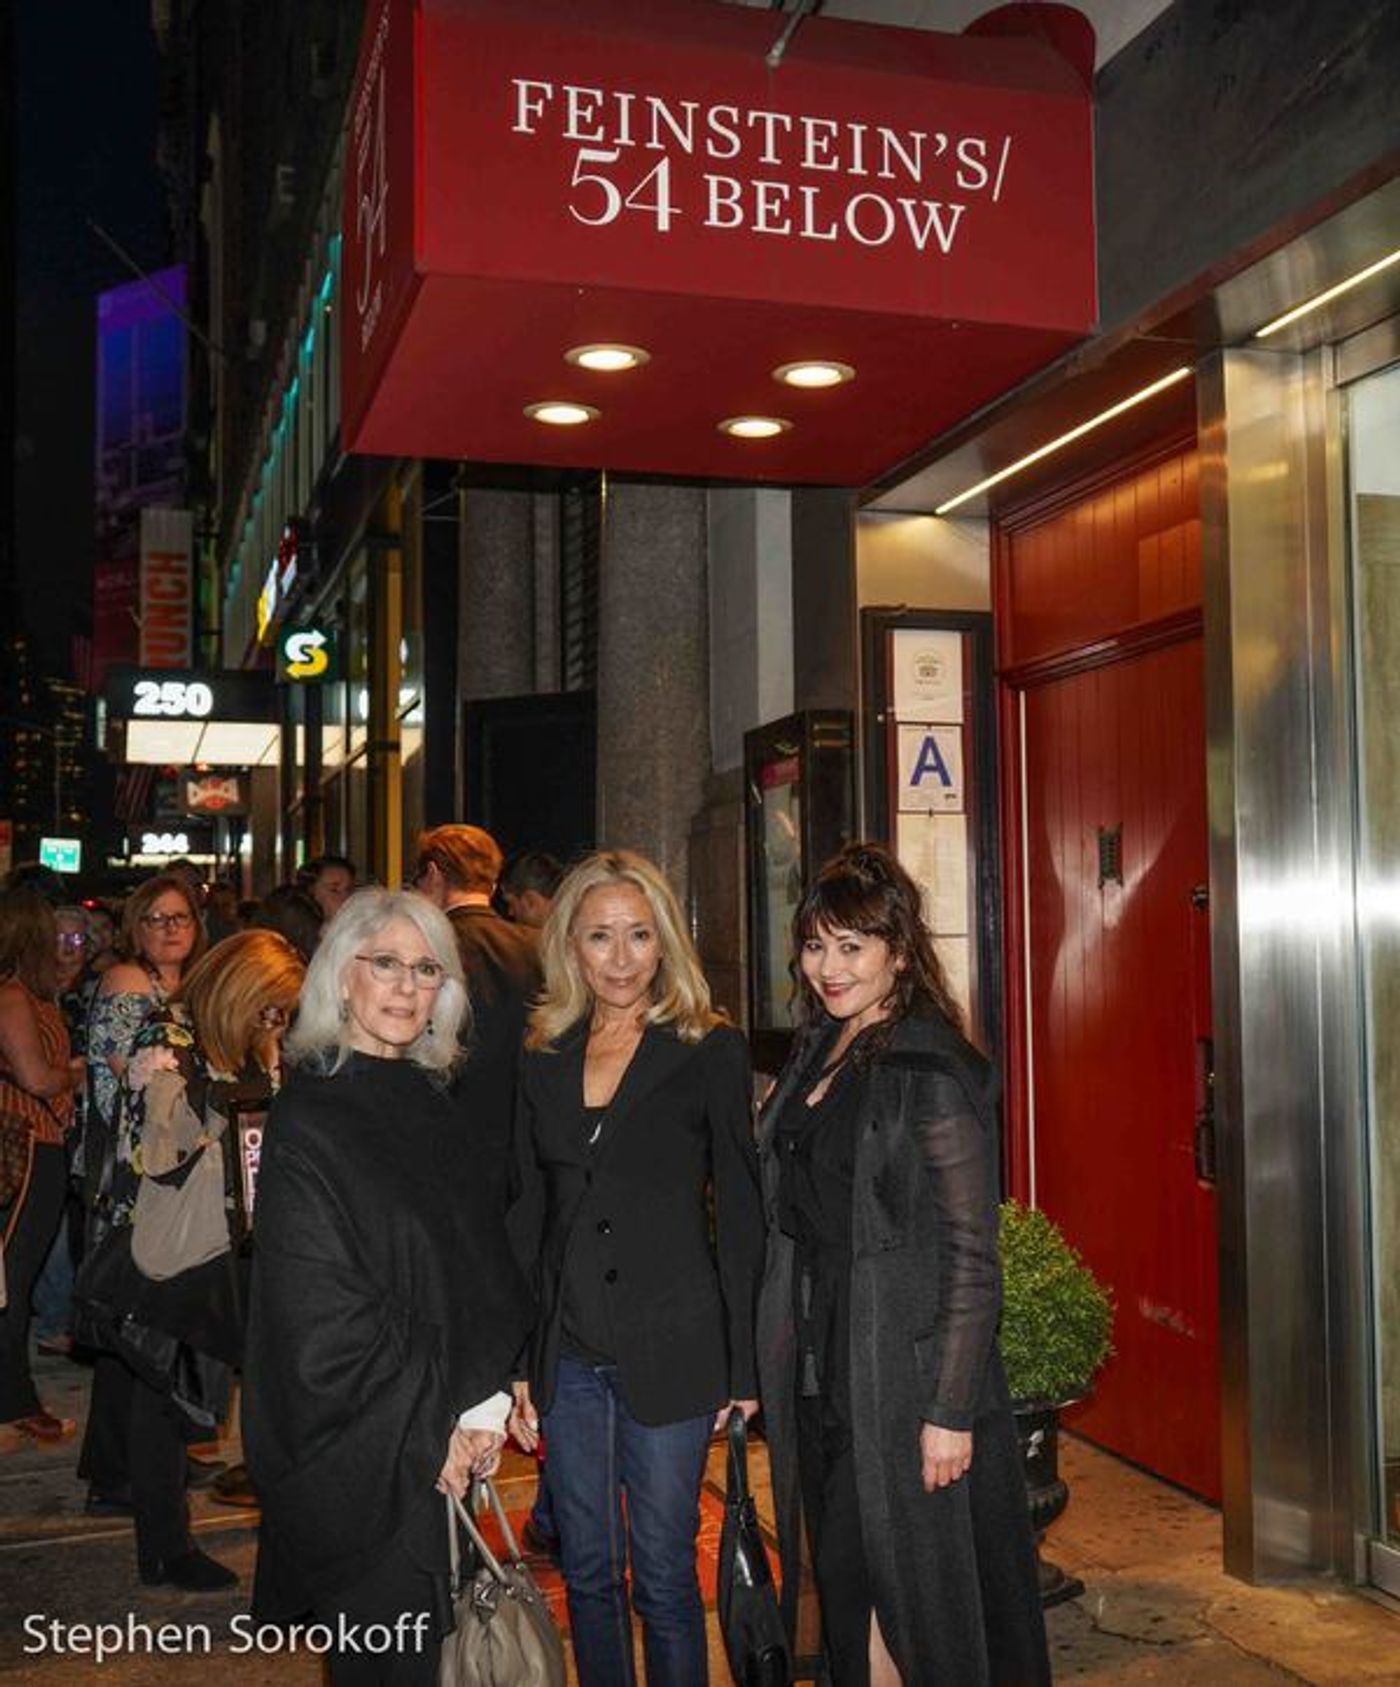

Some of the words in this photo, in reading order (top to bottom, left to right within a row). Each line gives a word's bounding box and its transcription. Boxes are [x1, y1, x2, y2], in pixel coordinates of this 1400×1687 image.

[568, 147, 683, 232] 54
[702, 174, 966, 254] BELOW
[145, 552, 188, 668] UNCH
[133, 681, 213, 716] 250
[909, 736, 953, 787] A
